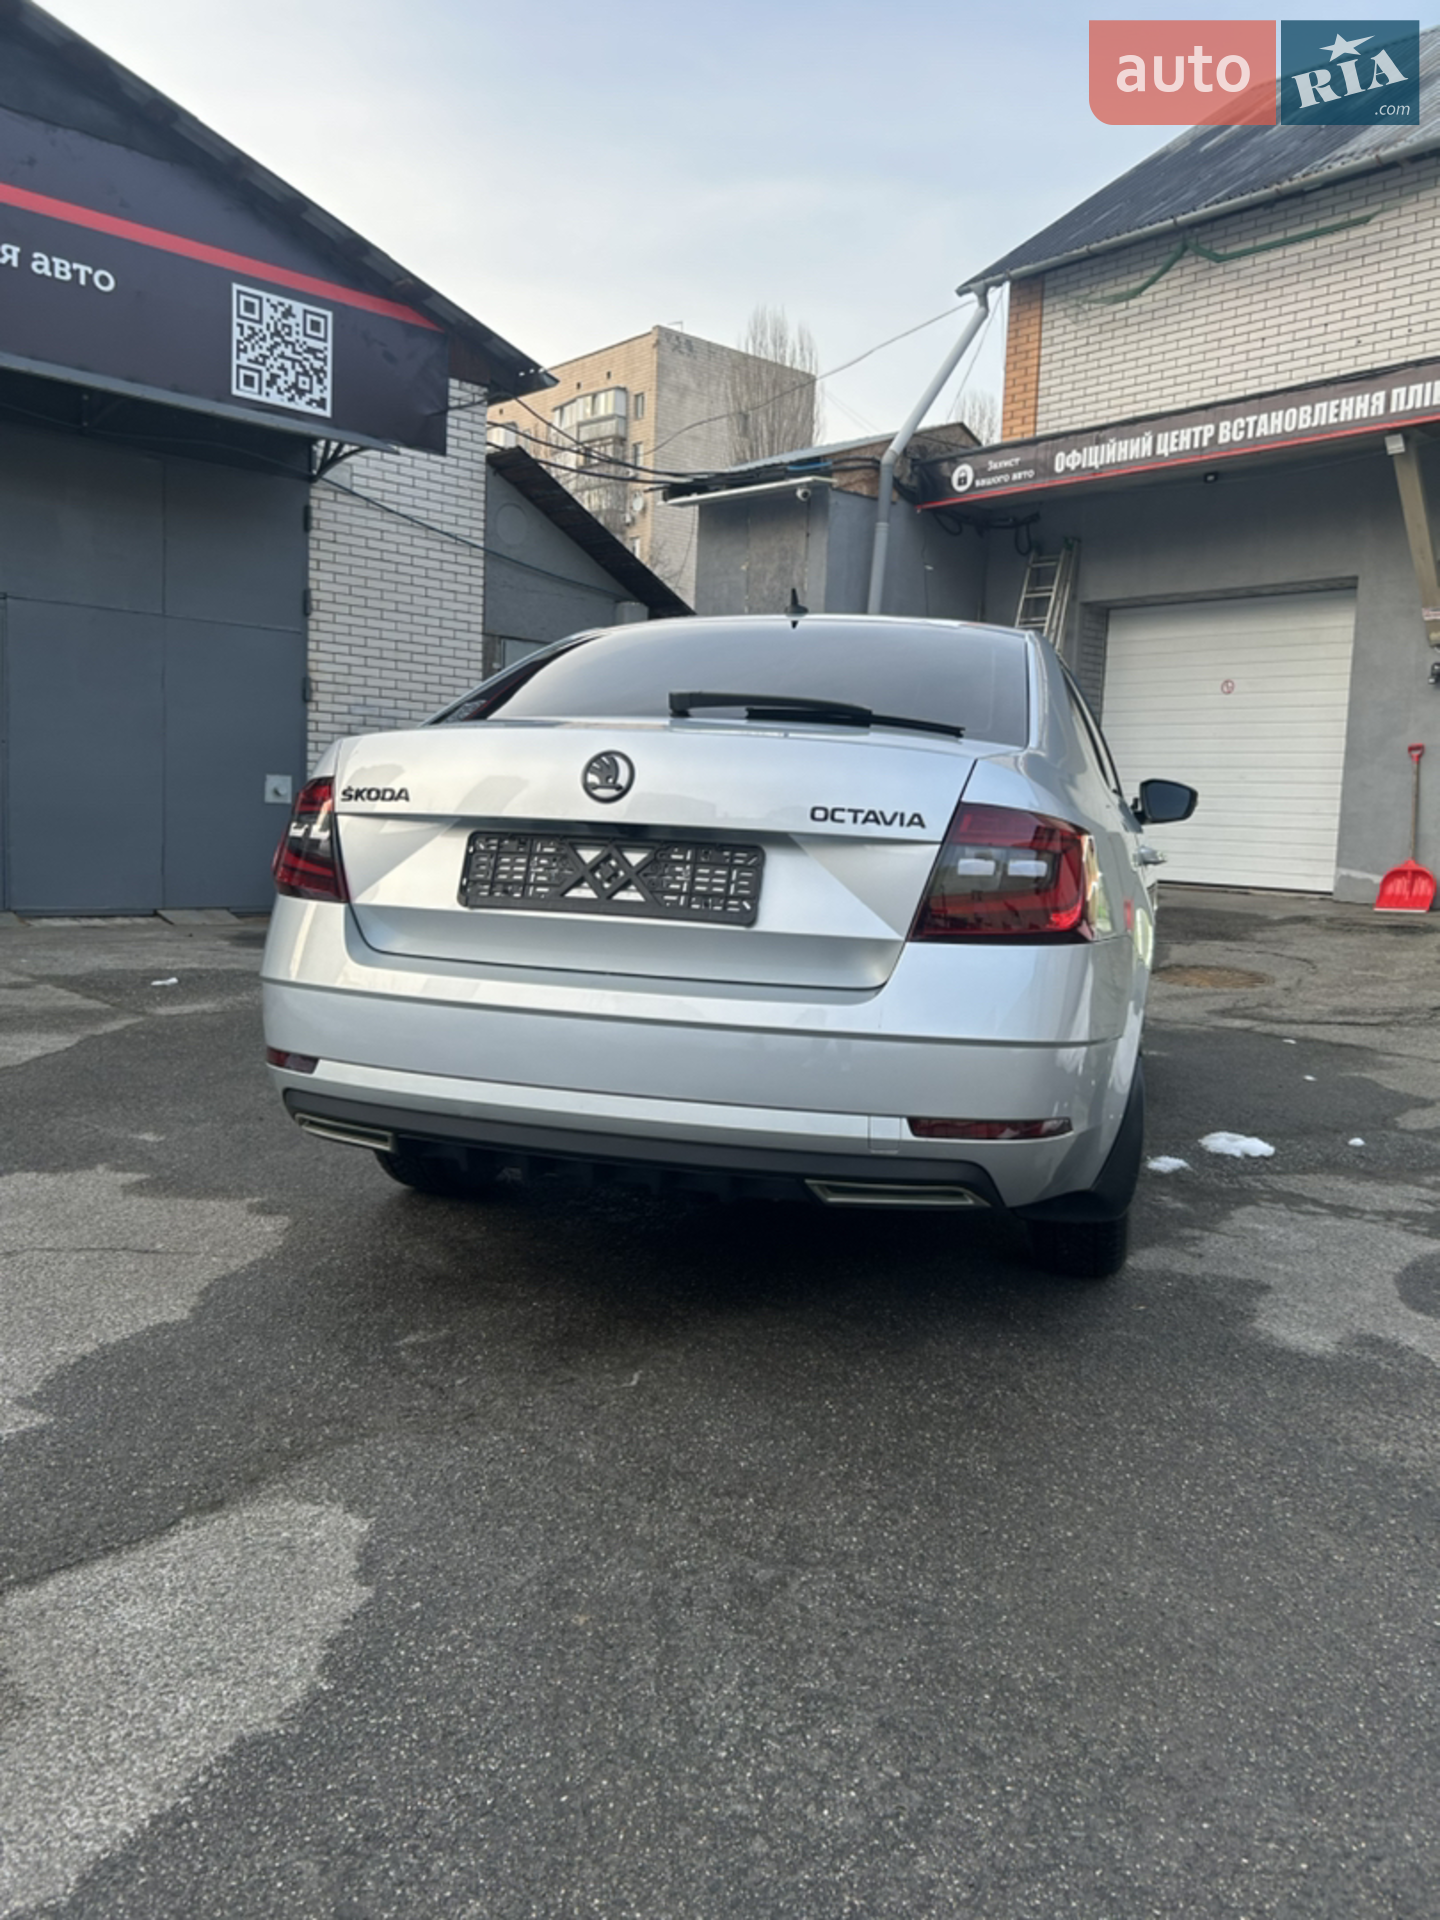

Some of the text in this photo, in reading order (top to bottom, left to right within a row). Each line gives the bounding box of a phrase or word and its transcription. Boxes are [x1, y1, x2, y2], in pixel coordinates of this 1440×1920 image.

[31, 252, 116, 292] авто
[1054, 431, 1154, 473] ОФІЦІЙНИЙ
[1156, 423, 1215, 457] ЦЕНТР
[1217, 390, 1386, 445] ВСТАНОВЛЕННЯ
[341, 785, 410, 802] ŠKODA
[810, 806, 926, 829] OCTAVIA
